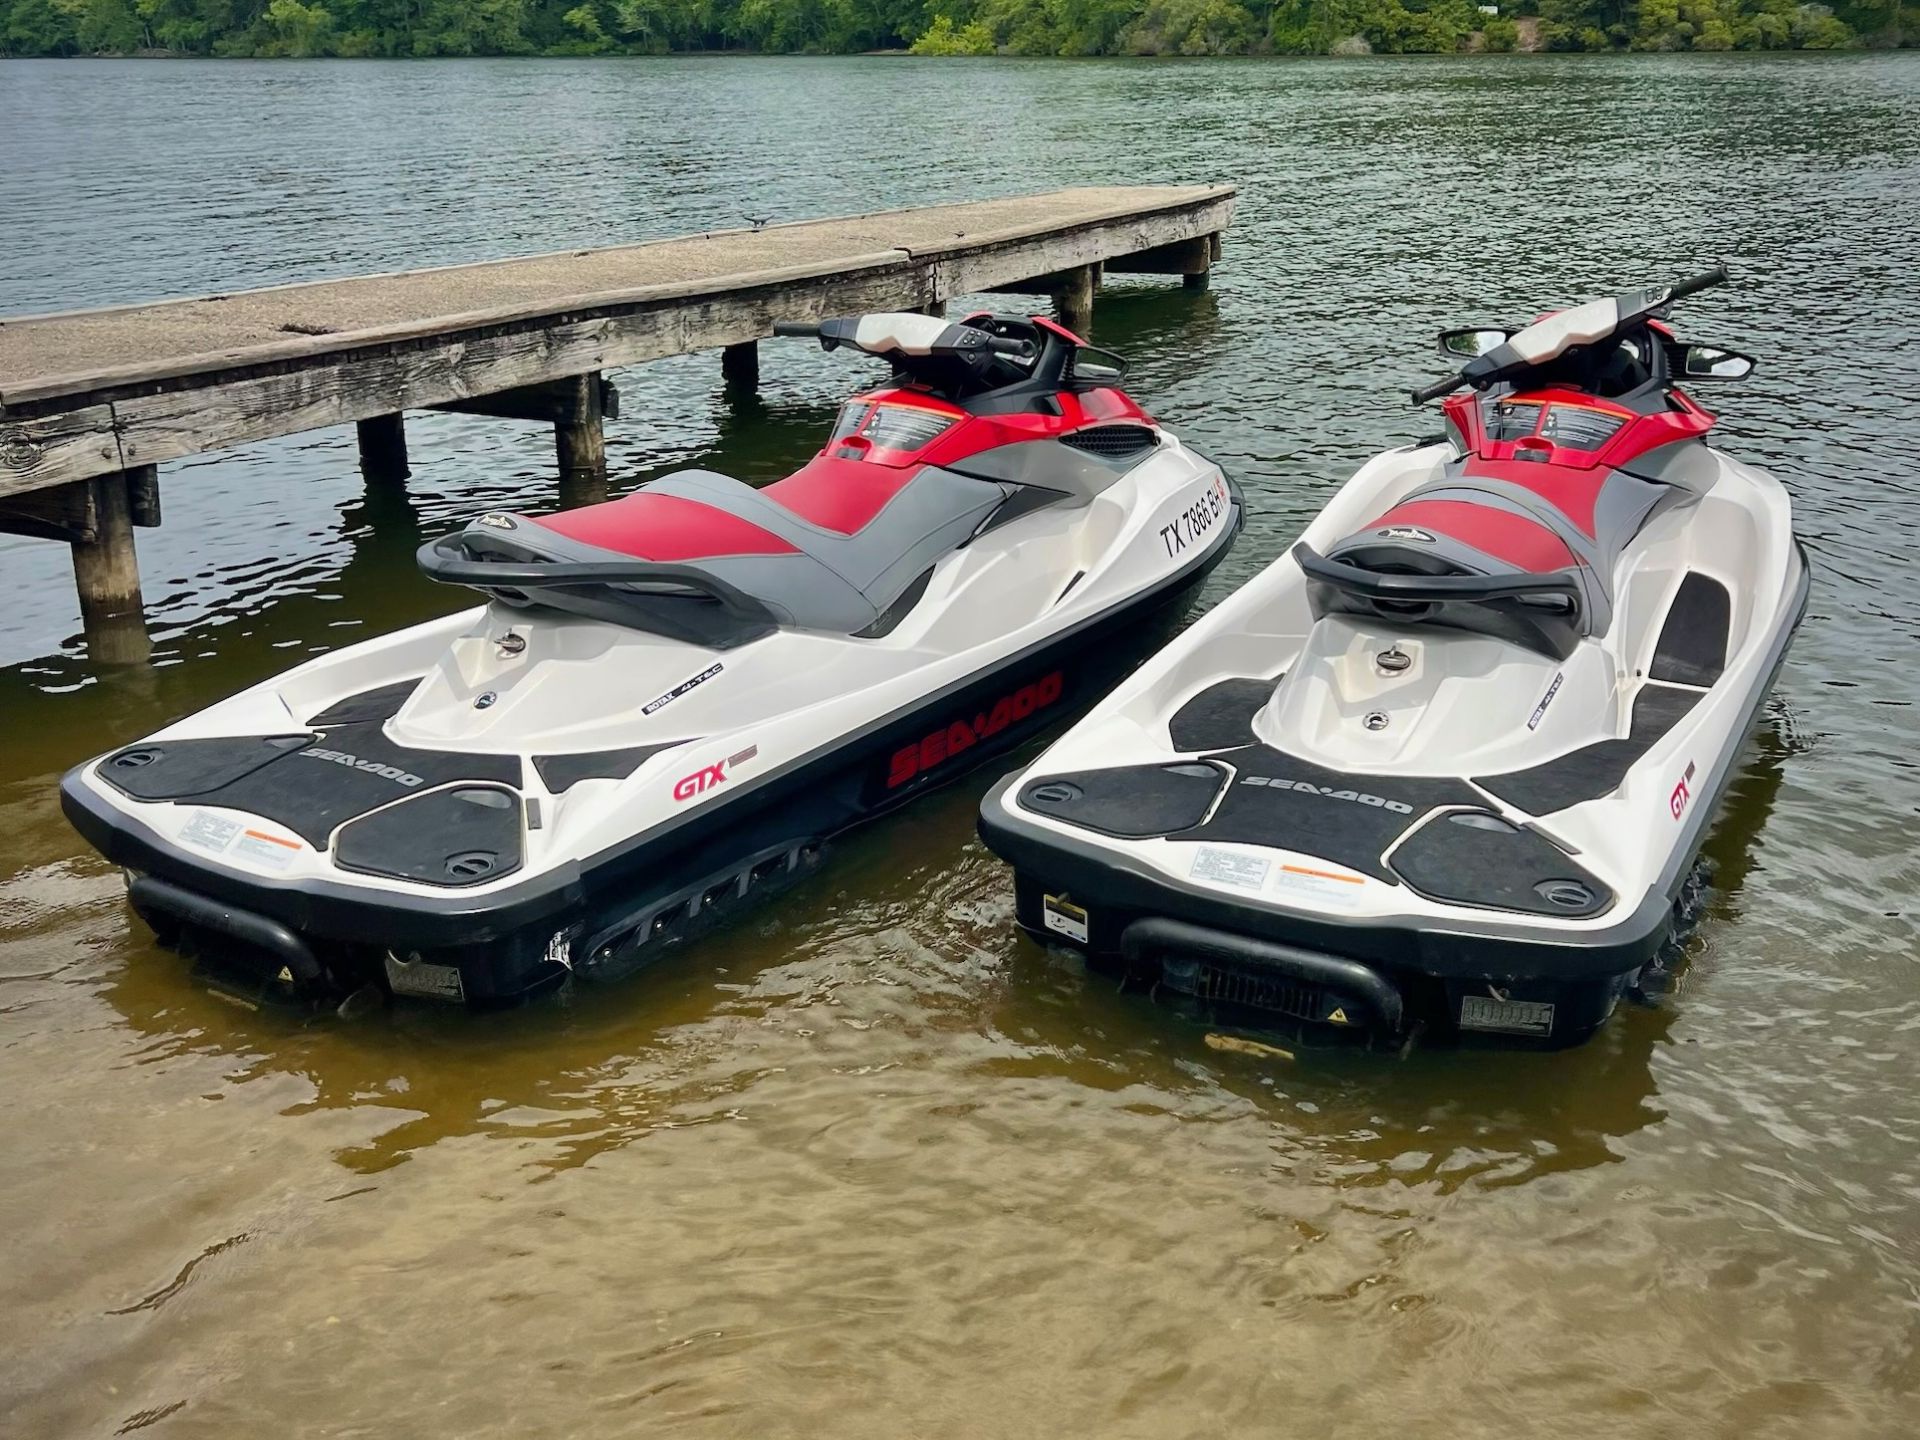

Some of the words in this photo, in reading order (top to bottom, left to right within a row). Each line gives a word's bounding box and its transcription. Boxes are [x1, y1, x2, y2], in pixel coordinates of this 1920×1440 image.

[1160, 519, 1186, 558] TX
[1182, 497, 1212, 542] 7866
[646, 692, 676, 712] ROTAX
[673, 758, 728, 802] GTX
[1670, 775, 1690, 820] GTX
